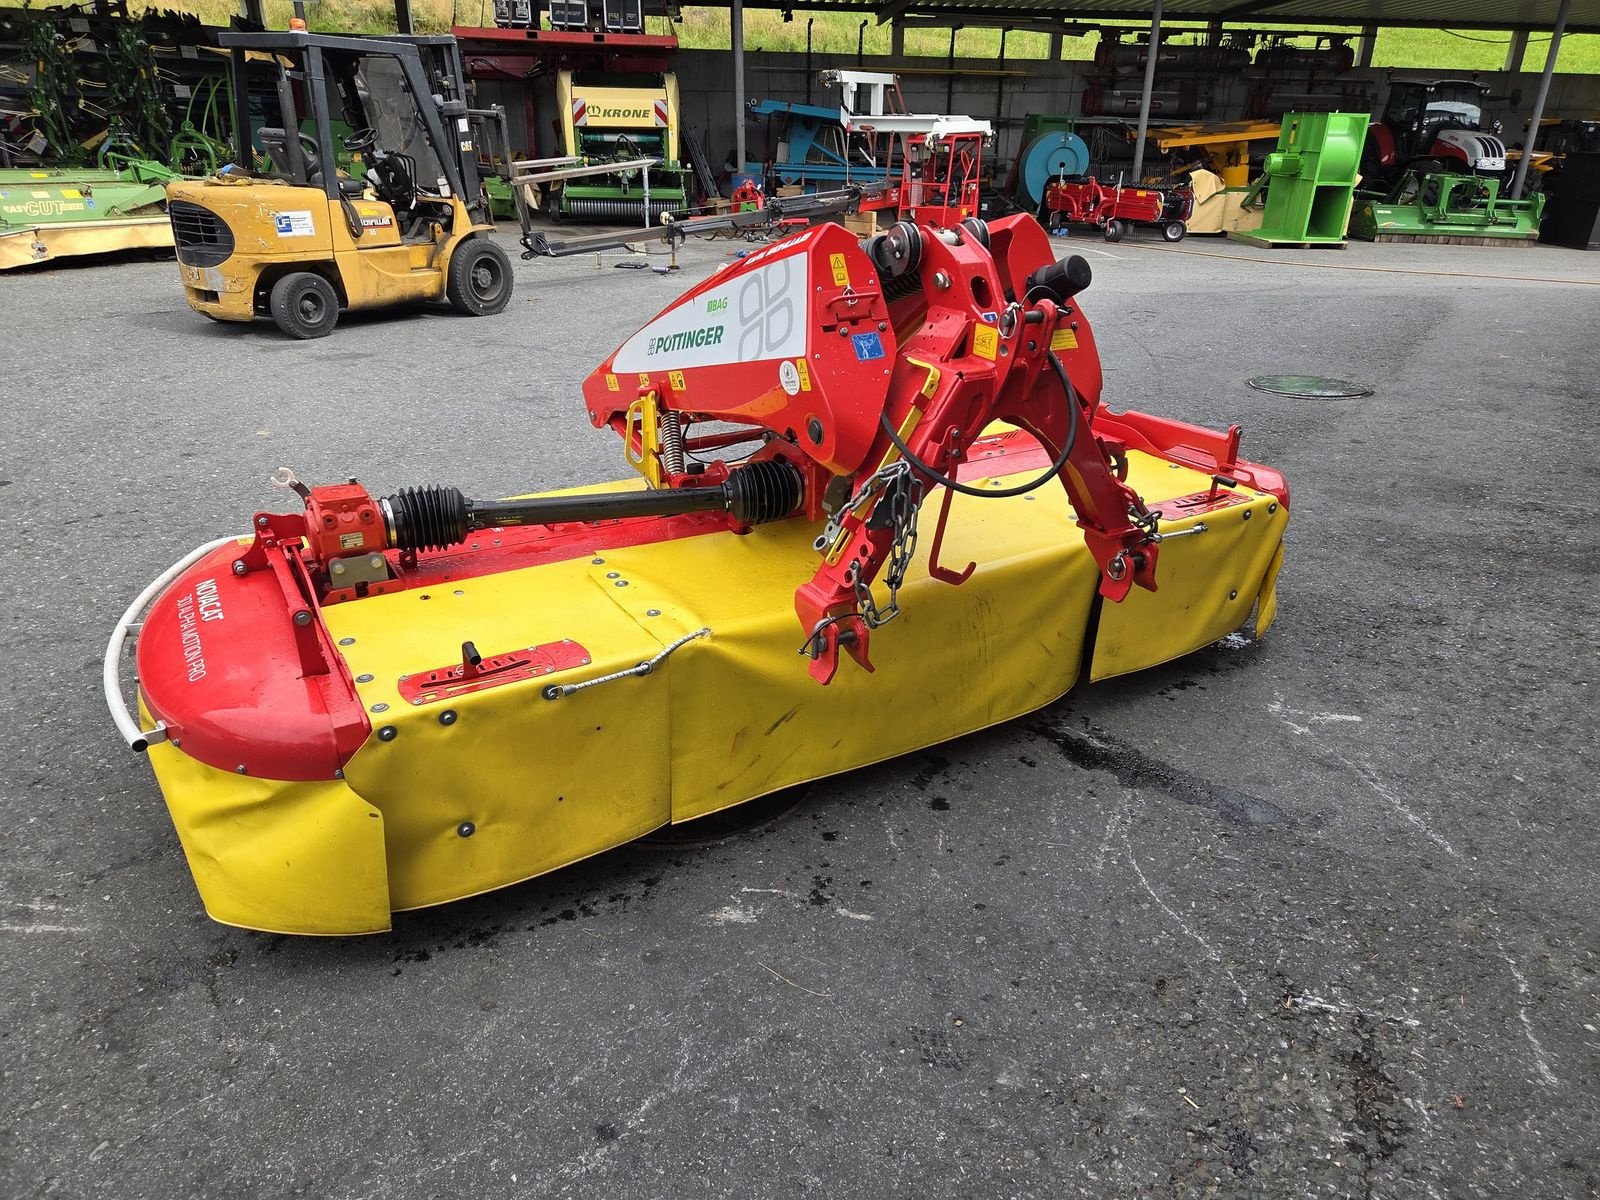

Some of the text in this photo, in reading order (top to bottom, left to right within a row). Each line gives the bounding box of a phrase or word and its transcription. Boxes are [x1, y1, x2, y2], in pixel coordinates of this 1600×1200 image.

[602, 108, 651, 118] KRONE
[460, 140, 473, 152] CAT
[195, 578, 225, 622] NOVACAT
[178, 605, 198, 632] ALPHA
[181, 626, 203, 663] MOTION
[187, 658, 207, 682] PRO
